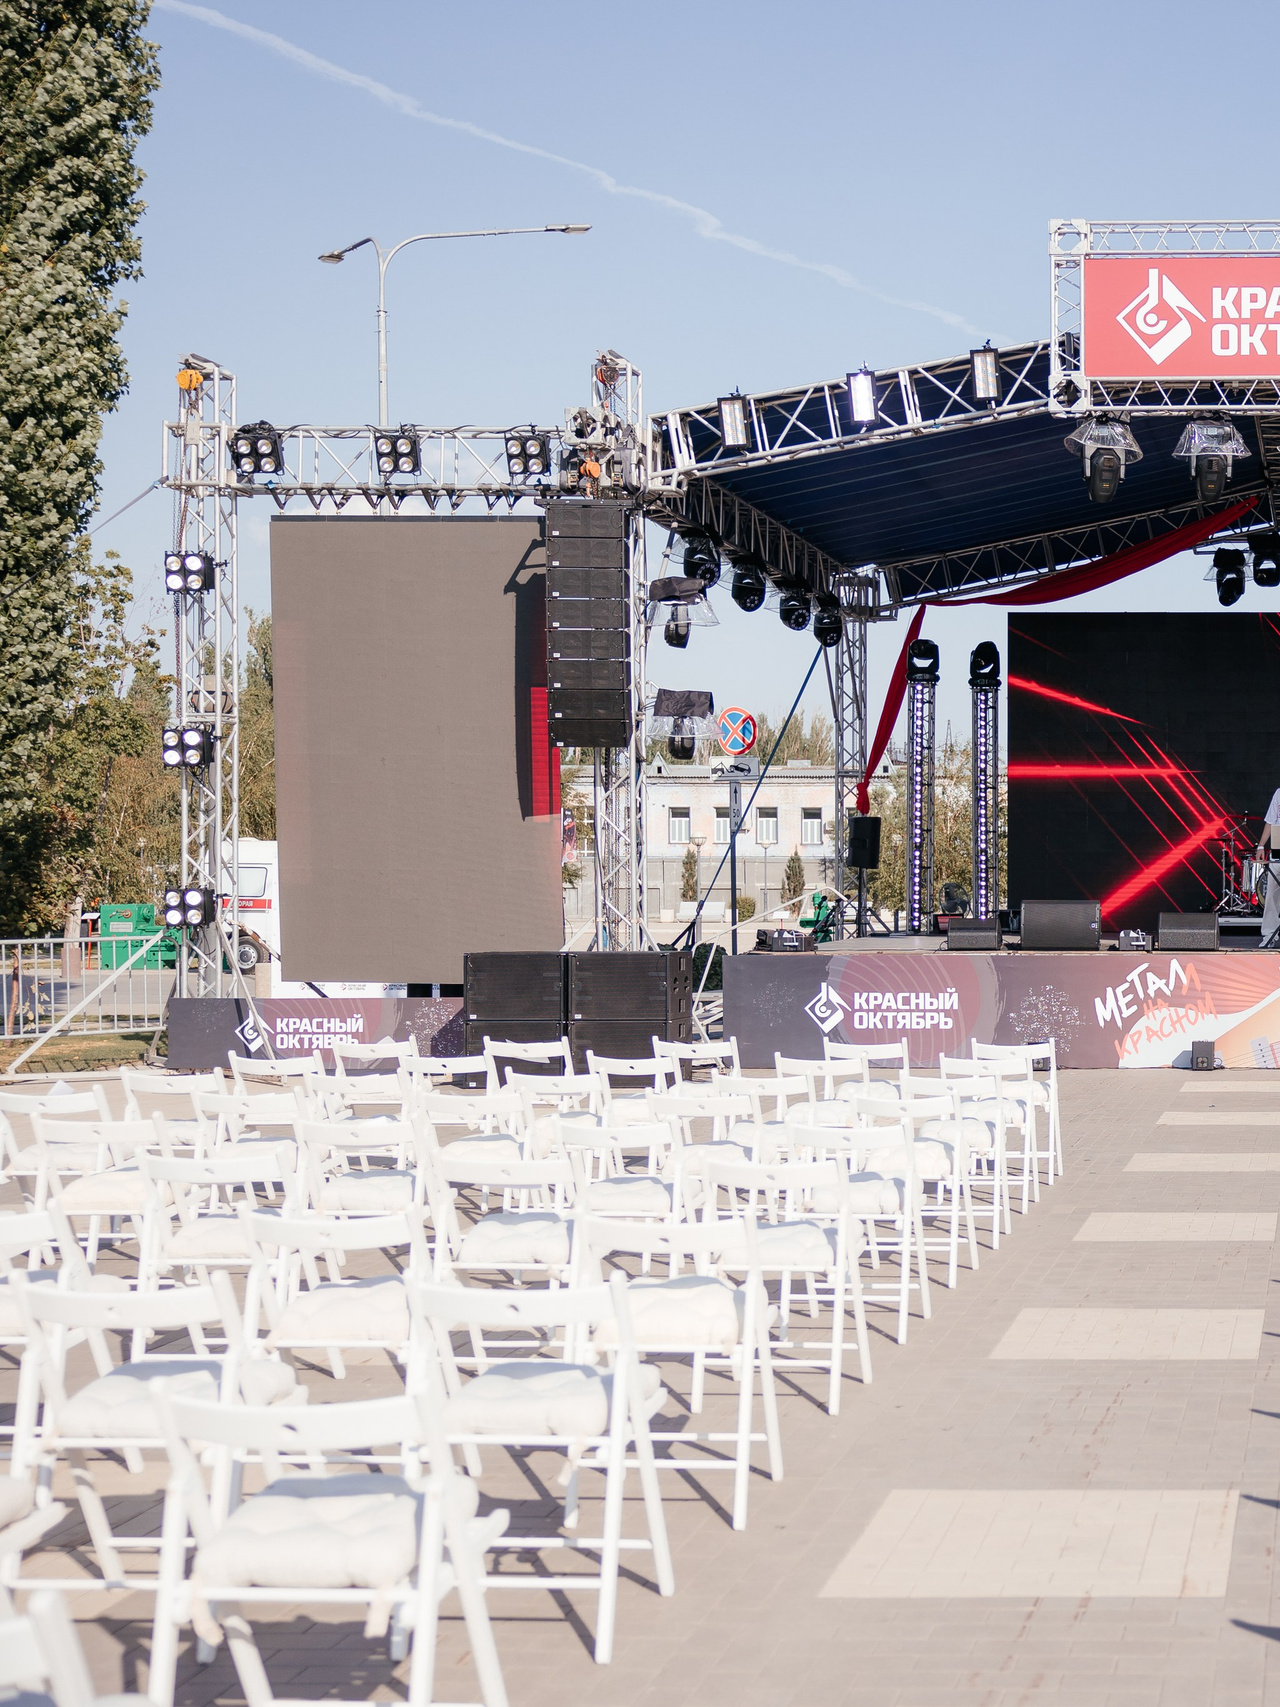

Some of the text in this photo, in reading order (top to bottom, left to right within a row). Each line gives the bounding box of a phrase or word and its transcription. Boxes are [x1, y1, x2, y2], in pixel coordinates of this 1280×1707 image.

[733, 809, 740, 818] 50
[853, 987, 959, 1010] КРАСНЫЙ
[1094, 958, 1201, 1030] МЕТАЛЛ
[853, 1011, 954, 1030] ОКТЯБРЬ
[1143, 998, 1170, 1021] НА
[275, 1013, 364, 1033] КРАСНЫЙ
[1114, 991, 1218, 1060] КРАСНОМ
